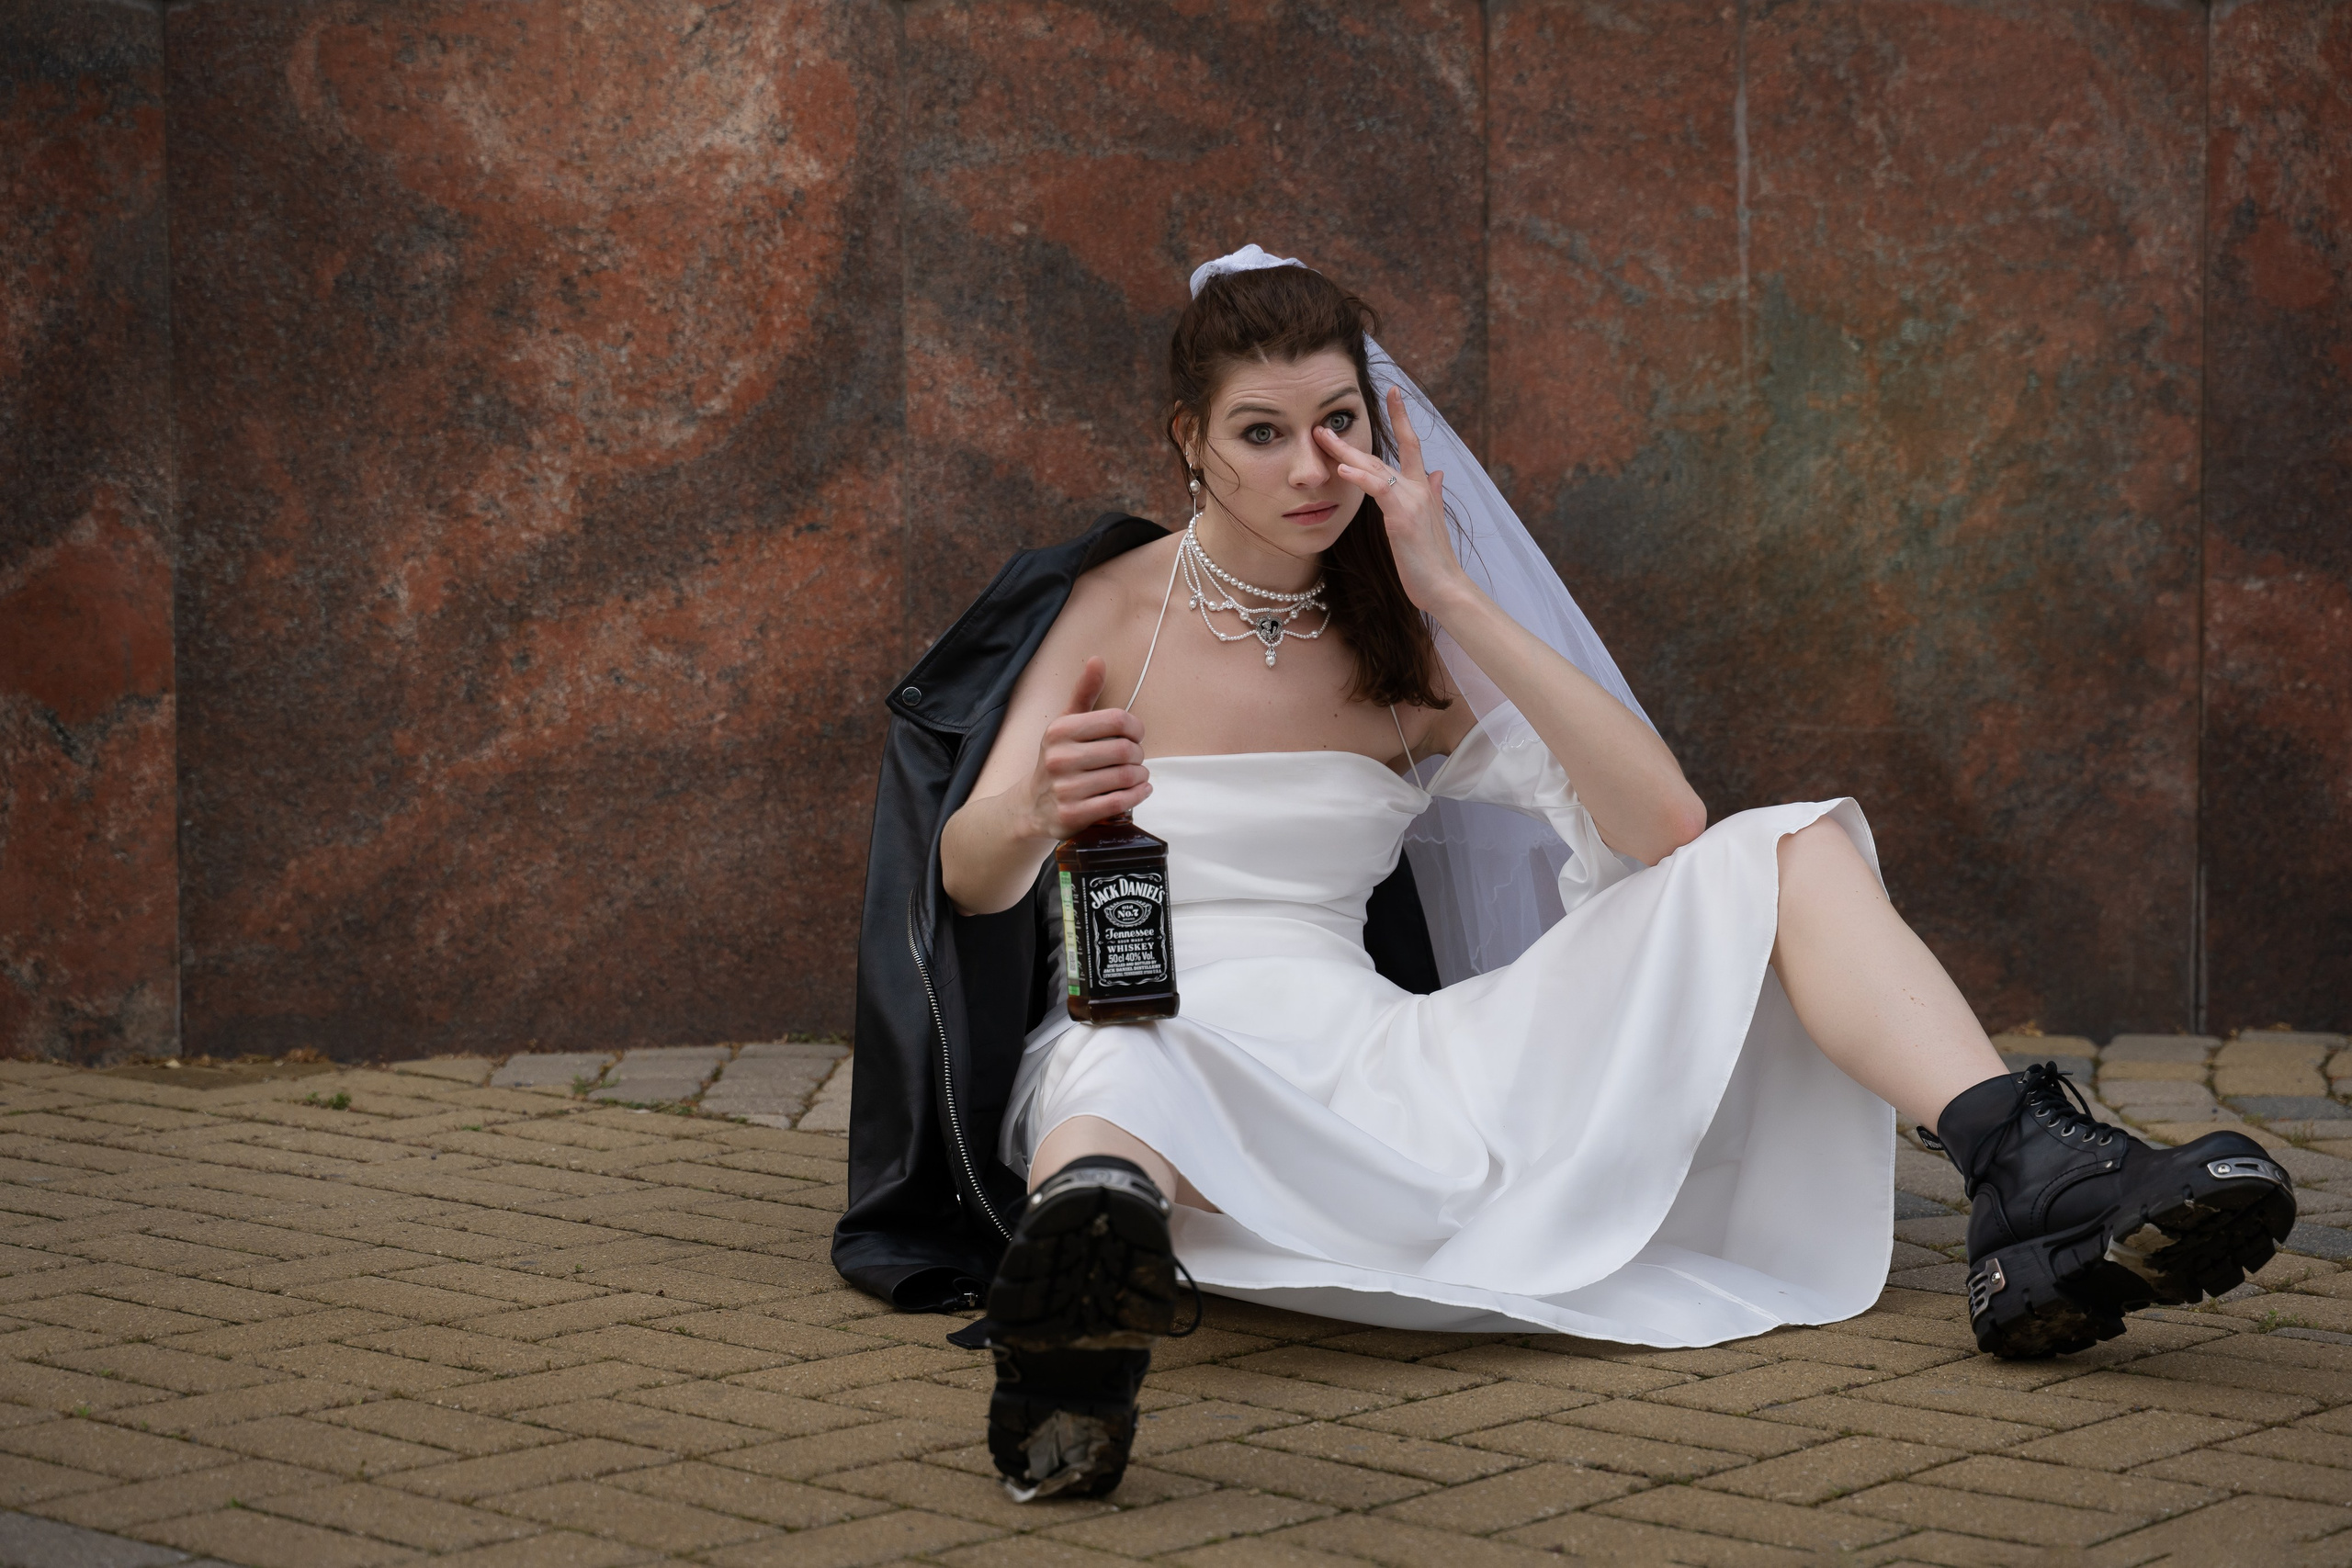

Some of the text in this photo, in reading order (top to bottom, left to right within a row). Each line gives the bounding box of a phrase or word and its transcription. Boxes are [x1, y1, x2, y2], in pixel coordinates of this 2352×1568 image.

[1090, 878, 1166, 909] JACK DANIEL'S
[1117, 908, 1139, 919] No.7
[1105, 928, 1155, 940] Tennessee
[1107, 942, 1155, 953] WHISKEY
[1125, 952, 1141, 962] 40%
[1141, 951, 1155, 960] Vol.
